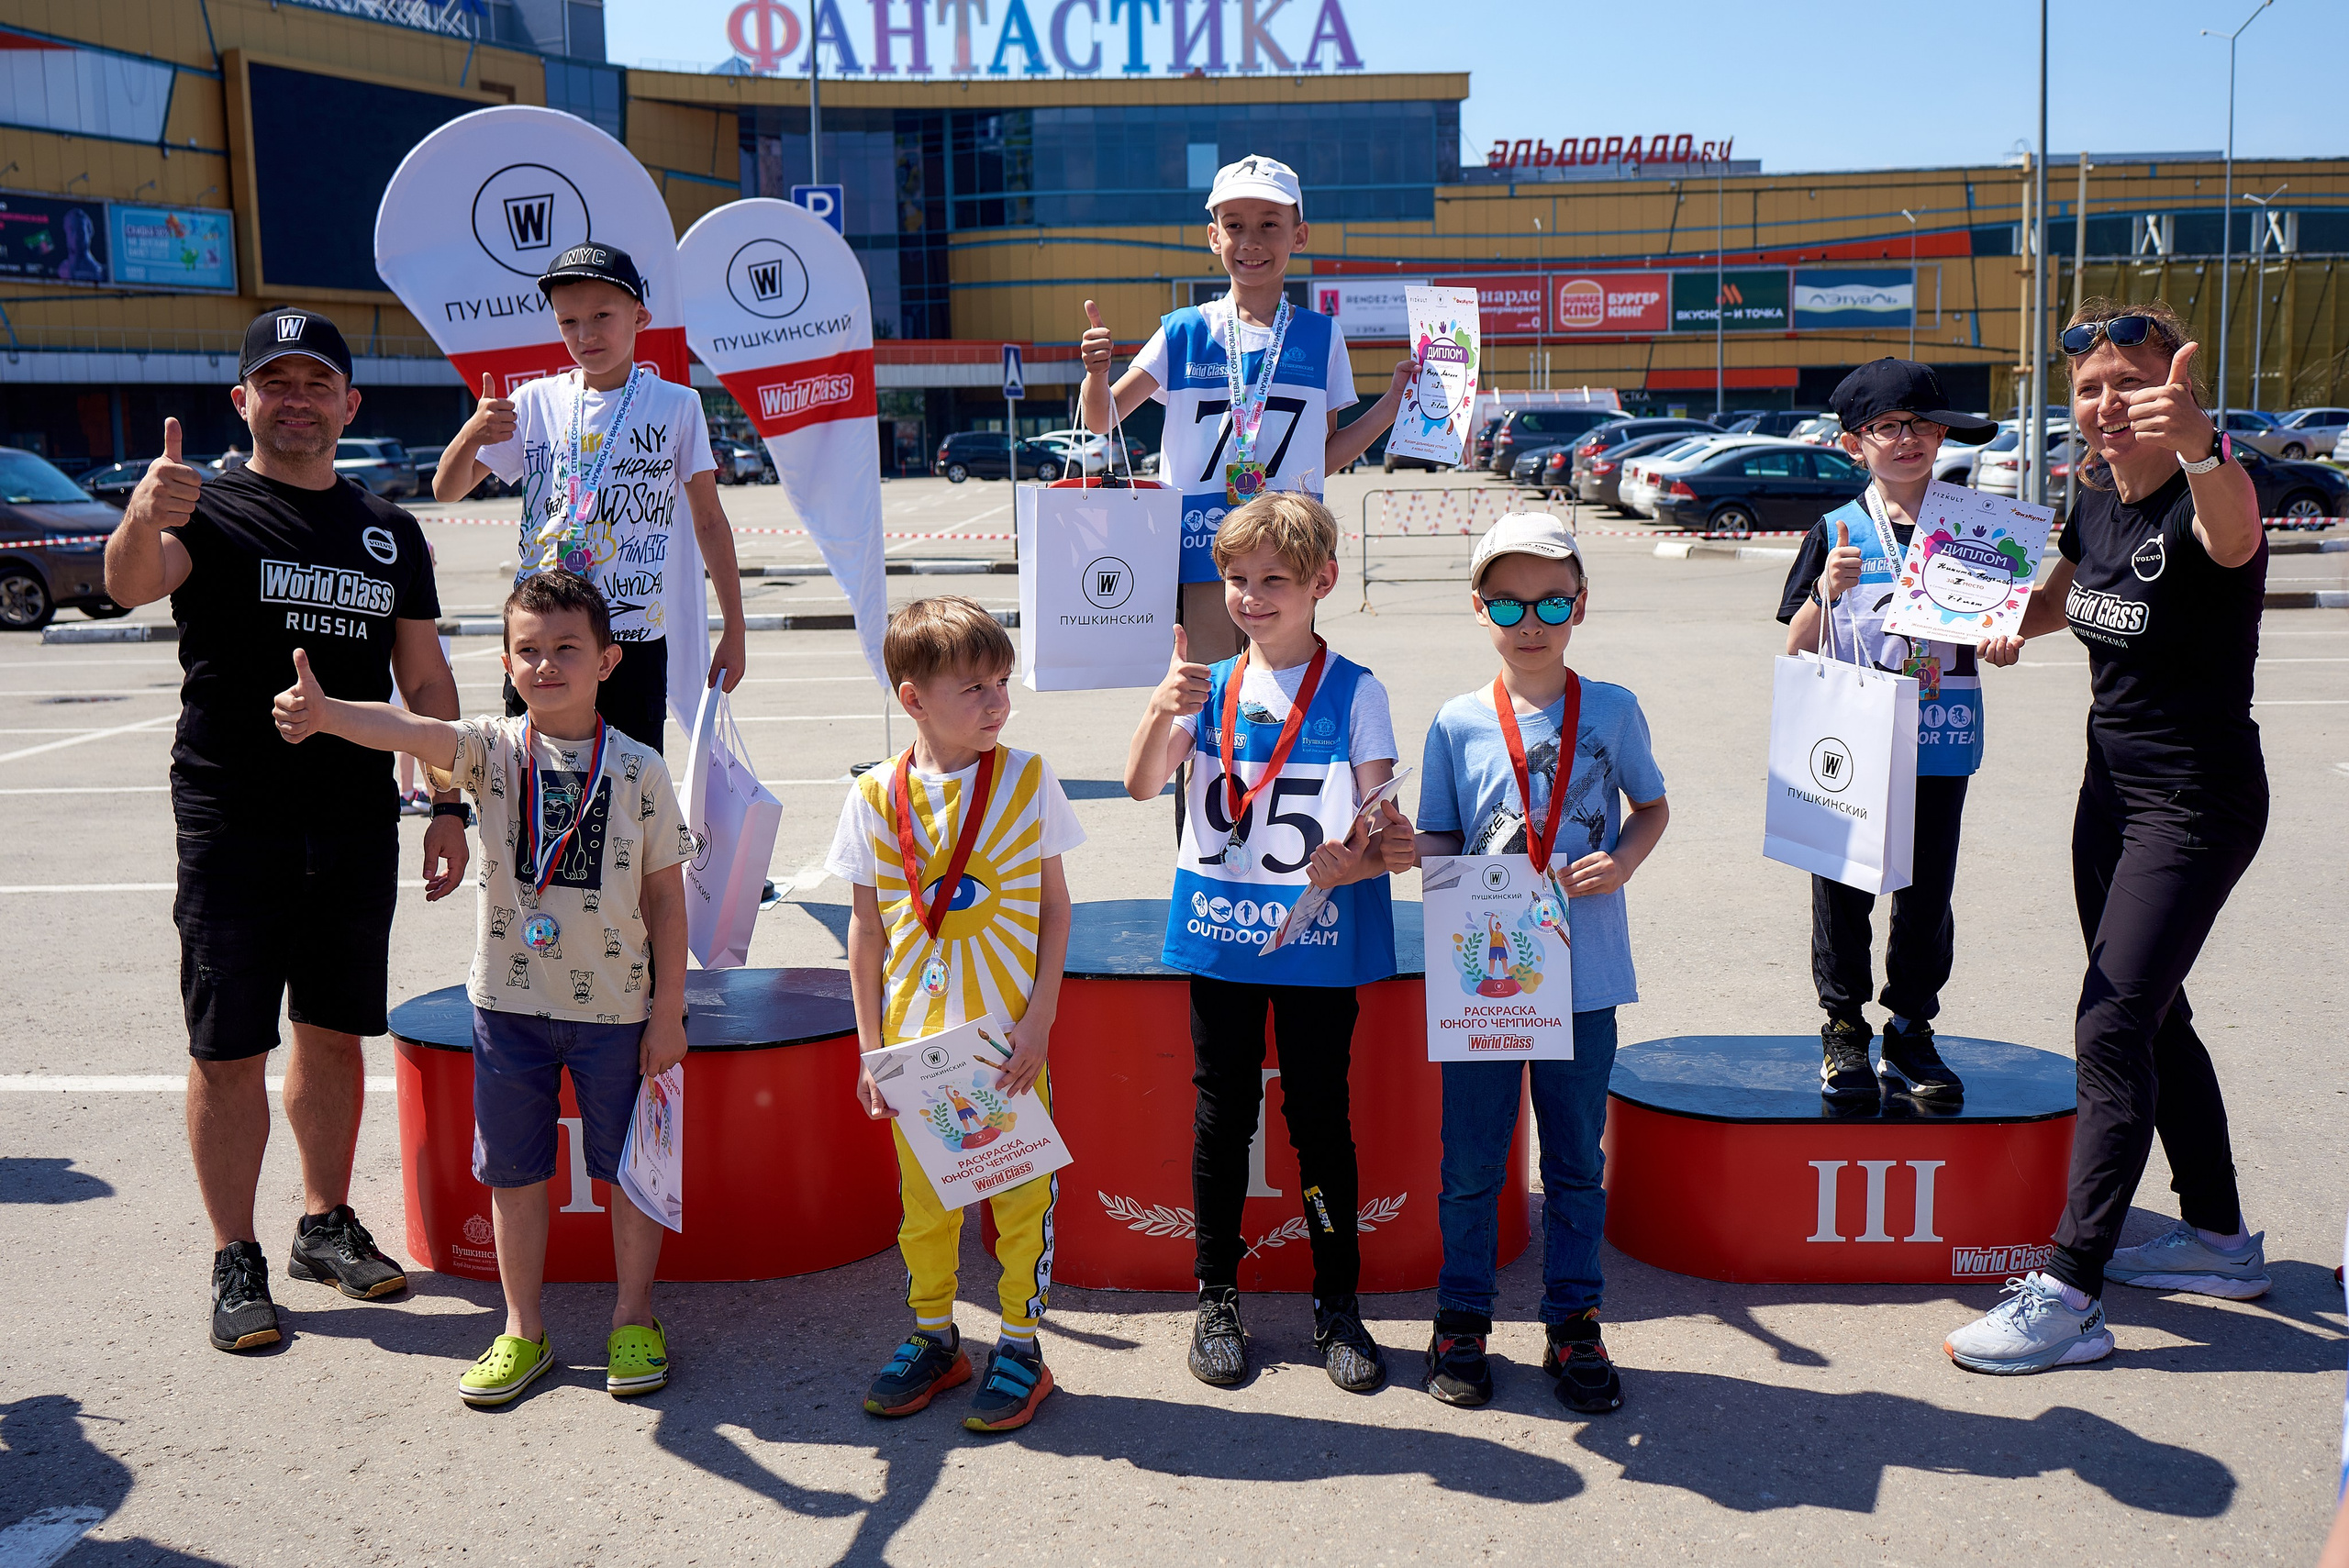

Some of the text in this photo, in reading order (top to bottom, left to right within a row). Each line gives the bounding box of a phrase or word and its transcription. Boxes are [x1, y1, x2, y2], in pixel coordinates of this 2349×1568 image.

[727, 0, 1364, 74] ФАНТАСТИКА
[806, 190, 834, 221] P
[512, 201, 546, 244] W
[564, 247, 607, 267] NYC
[754, 265, 775, 296] W
[1564, 304, 1601, 317] KING
[1607, 292, 1660, 306] БУРГЕР
[1608, 306, 1644, 318] КИНГ
[1271, 302, 1288, 348] СОРЕВНОВАНИЯ
[1676, 308, 1720, 320] ВКУСНО
[1745, 307, 1784, 319] ТОЧКА
[279, 317, 303, 340] W
[713, 314, 852, 353] ПУШКИНСКИЙ
[1228, 318, 1238, 373] СОРЕВНОВАНИЯ
[1427, 346, 1464, 361] ДИПЛОМ
[1186, 363, 1229, 377] World Class
[1258, 359, 1274, 395] РОЛИКАМ
[763, 377, 850, 416] World Class
[1233, 374, 1242, 406] СЕТЕВЫЕ
[608, 385, 635, 437] СОРЕВНОВАНИЯ
[1196, 395, 1307, 482] 77
[590, 450, 608, 486] РОЛИКАМ
[369, 539, 393, 550] VOLVO
[1941, 543, 2008, 567] ДИПЛОМ
[2134, 553, 2161, 562] VOLVO
[266, 563, 392, 611] World Class
[1101, 574, 1116, 593] W
[1963, 580, 1984, 590] место
[285, 611, 368, 639] RUSSIA
[1060, 612, 1154, 626] ПУШКИНСКИЙ
[2096, 597, 2143, 630] Class
[1826, 755, 1839, 776] W
[1787, 786, 1868, 819] ПУШКИНСКИЙ
[1198, 772, 1324, 873] 95
[1475, 814, 1506, 855] FORCE
[1471, 893, 1522, 901] ПУШКИНСКИЙ
[1291, 929, 1339, 946] EAM
[1441, 1018, 1562, 1029] ЮНОГО ЧЕМПИОНА
[1464, 1006, 1537, 1017] РАСКРАСКА
[1470, 1036, 1532, 1051] World Class
[920, 1061, 967, 1082] ПУШКИНСКИЙ
[941, 1137, 1052, 1184] ЮНОГО ЧЕМПИОНА
[957, 1138, 1024, 1169] РАСКРАСКА
[975, 1162, 1032, 1192] World Class
[1806, 1160, 1946, 1242] III
[452, 1245, 497, 1258] Пушкинск
[1956, 1248, 2051, 1273] World Class
[2079, 1307, 2102, 1335] HOKA
